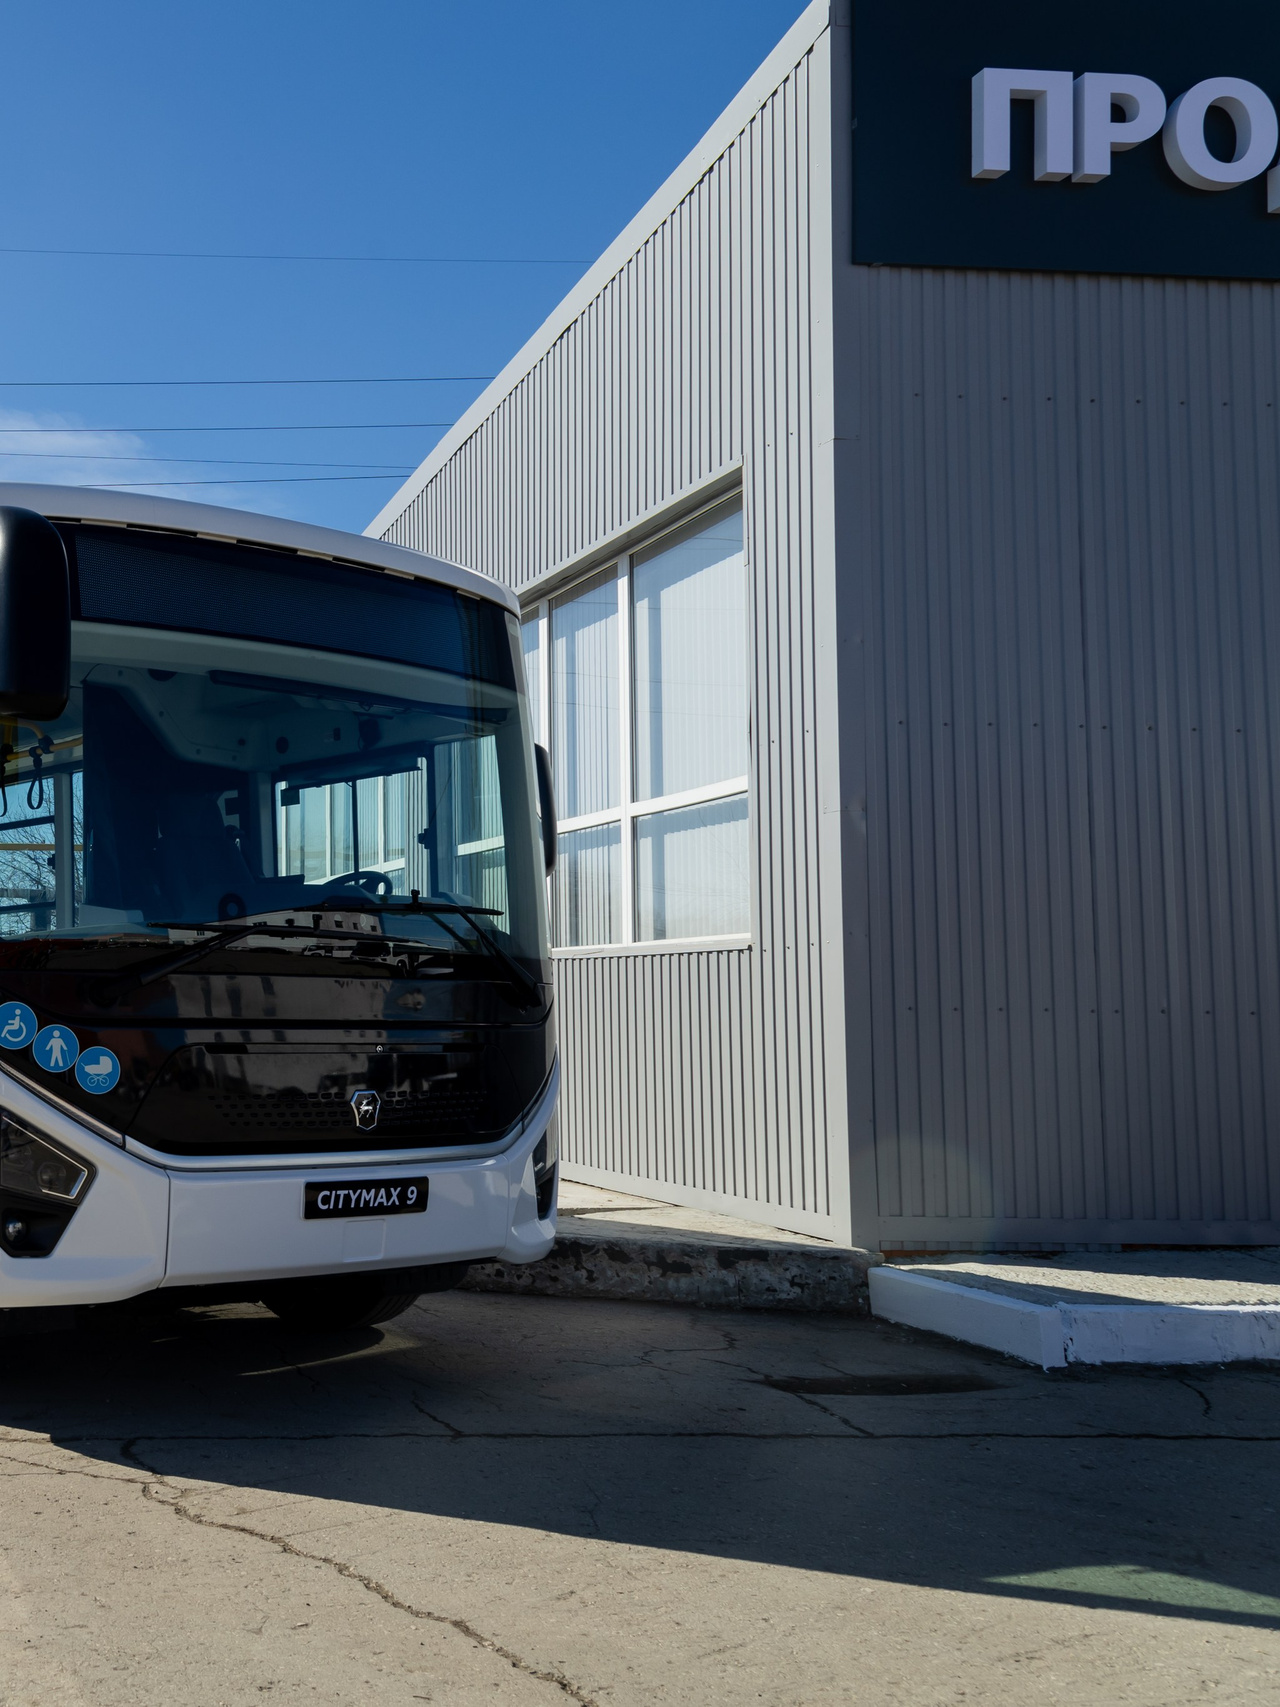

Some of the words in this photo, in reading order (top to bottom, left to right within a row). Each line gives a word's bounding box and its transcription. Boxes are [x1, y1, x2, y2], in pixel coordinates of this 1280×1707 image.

[971, 67, 1280, 214] ПРО
[317, 1187, 401, 1210] CITYMAX
[406, 1186, 418, 1205] 9
